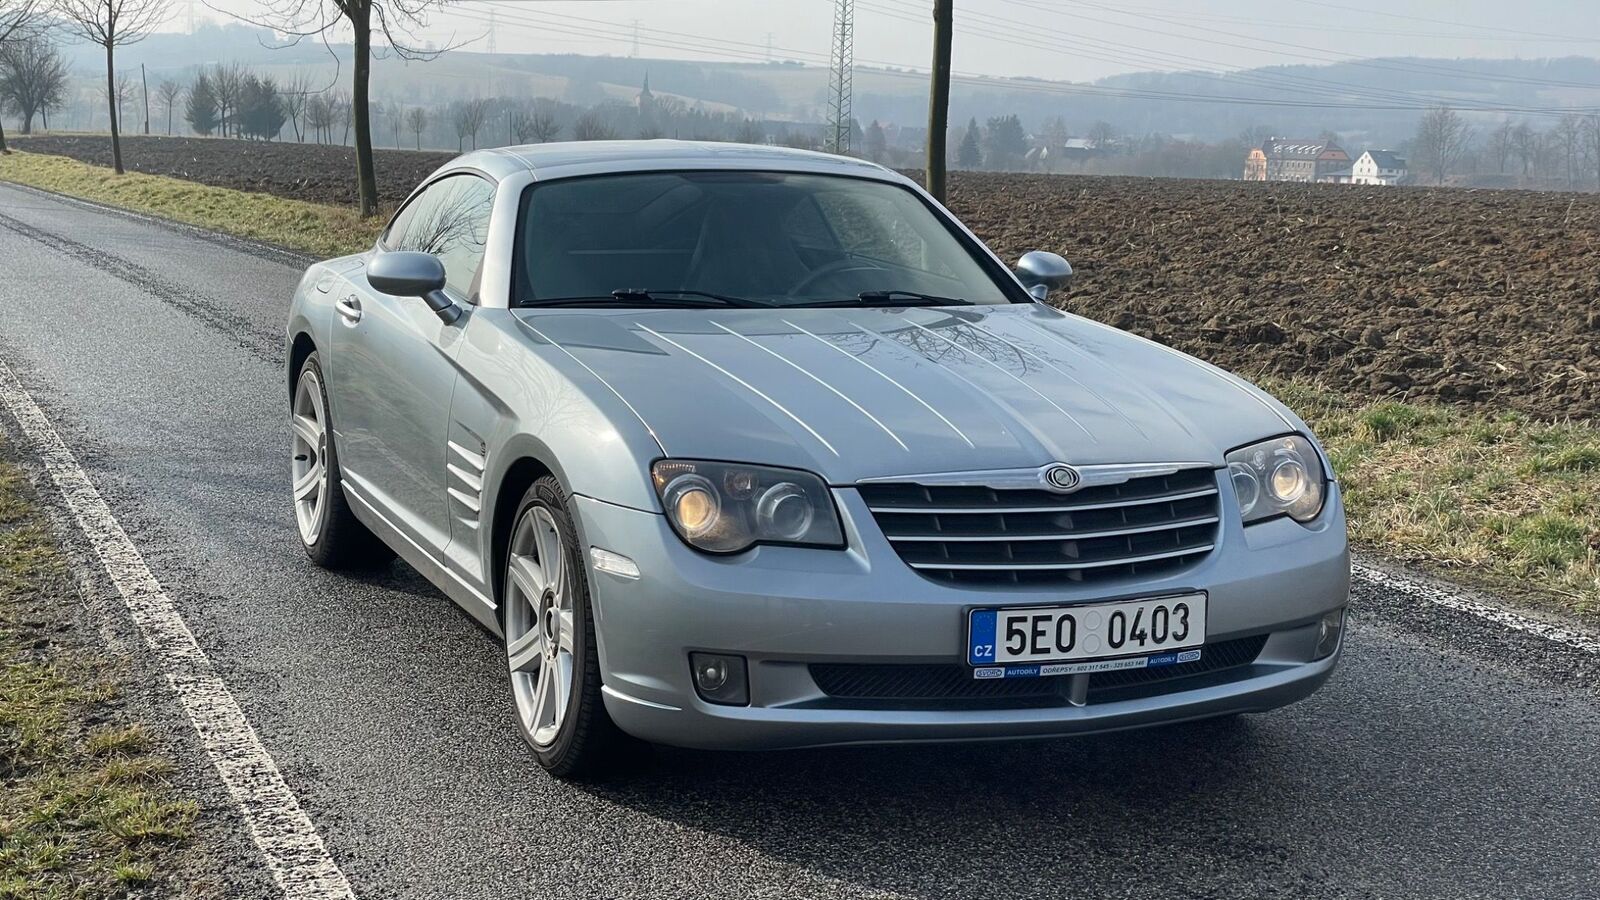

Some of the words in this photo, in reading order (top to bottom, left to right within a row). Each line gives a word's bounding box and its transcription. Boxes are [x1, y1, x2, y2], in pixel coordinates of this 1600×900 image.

[1005, 614, 1076, 656] 5E0
[1108, 602, 1190, 649] 0403
[974, 644, 993, 657] CZ
